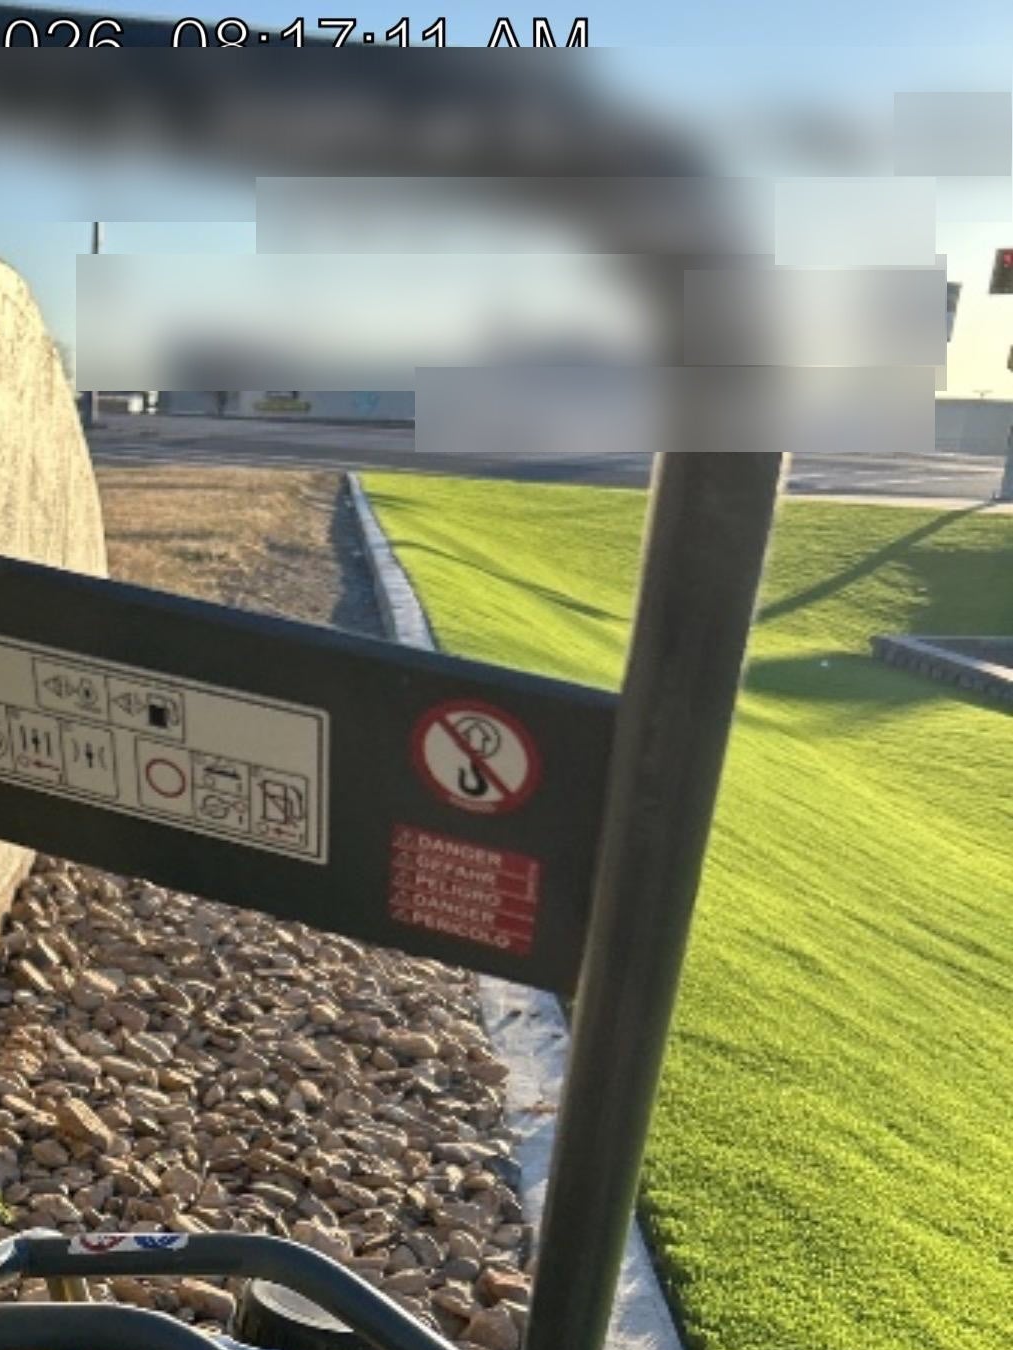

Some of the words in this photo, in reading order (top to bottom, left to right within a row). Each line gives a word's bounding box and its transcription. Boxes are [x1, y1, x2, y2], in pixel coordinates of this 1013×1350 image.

[418, 834, 501, 866] DANGER
[416, 854, 495, 884] GEFAHR
[415, 873, 501, 906] PELIGRO
[412, 893, 495, 922] DANGER
[412, 911, 510, 948] PERICOLO
